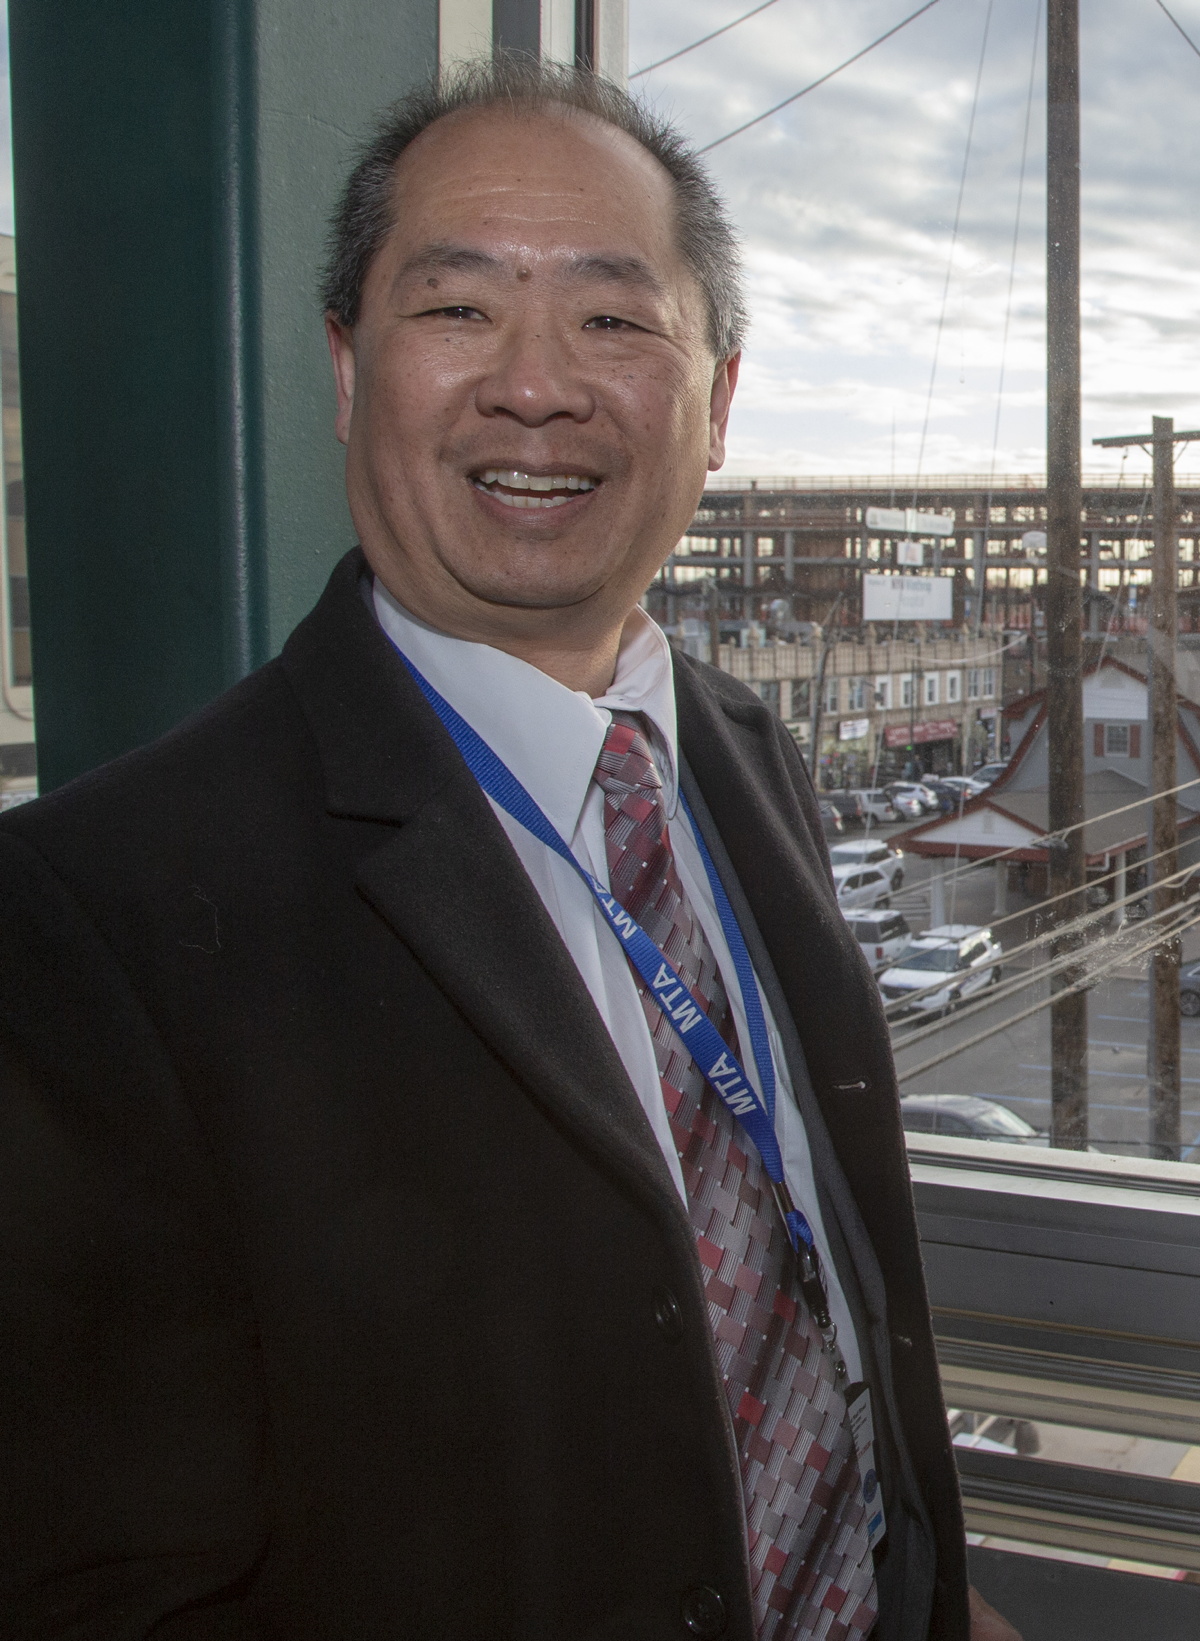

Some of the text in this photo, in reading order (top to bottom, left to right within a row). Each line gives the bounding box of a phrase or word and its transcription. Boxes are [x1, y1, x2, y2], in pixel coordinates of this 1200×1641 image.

[592, 877, 638, 939] MTA
[652, 962, 702, 1033] MTA
[708, 1052, 756, 1115] MTA
